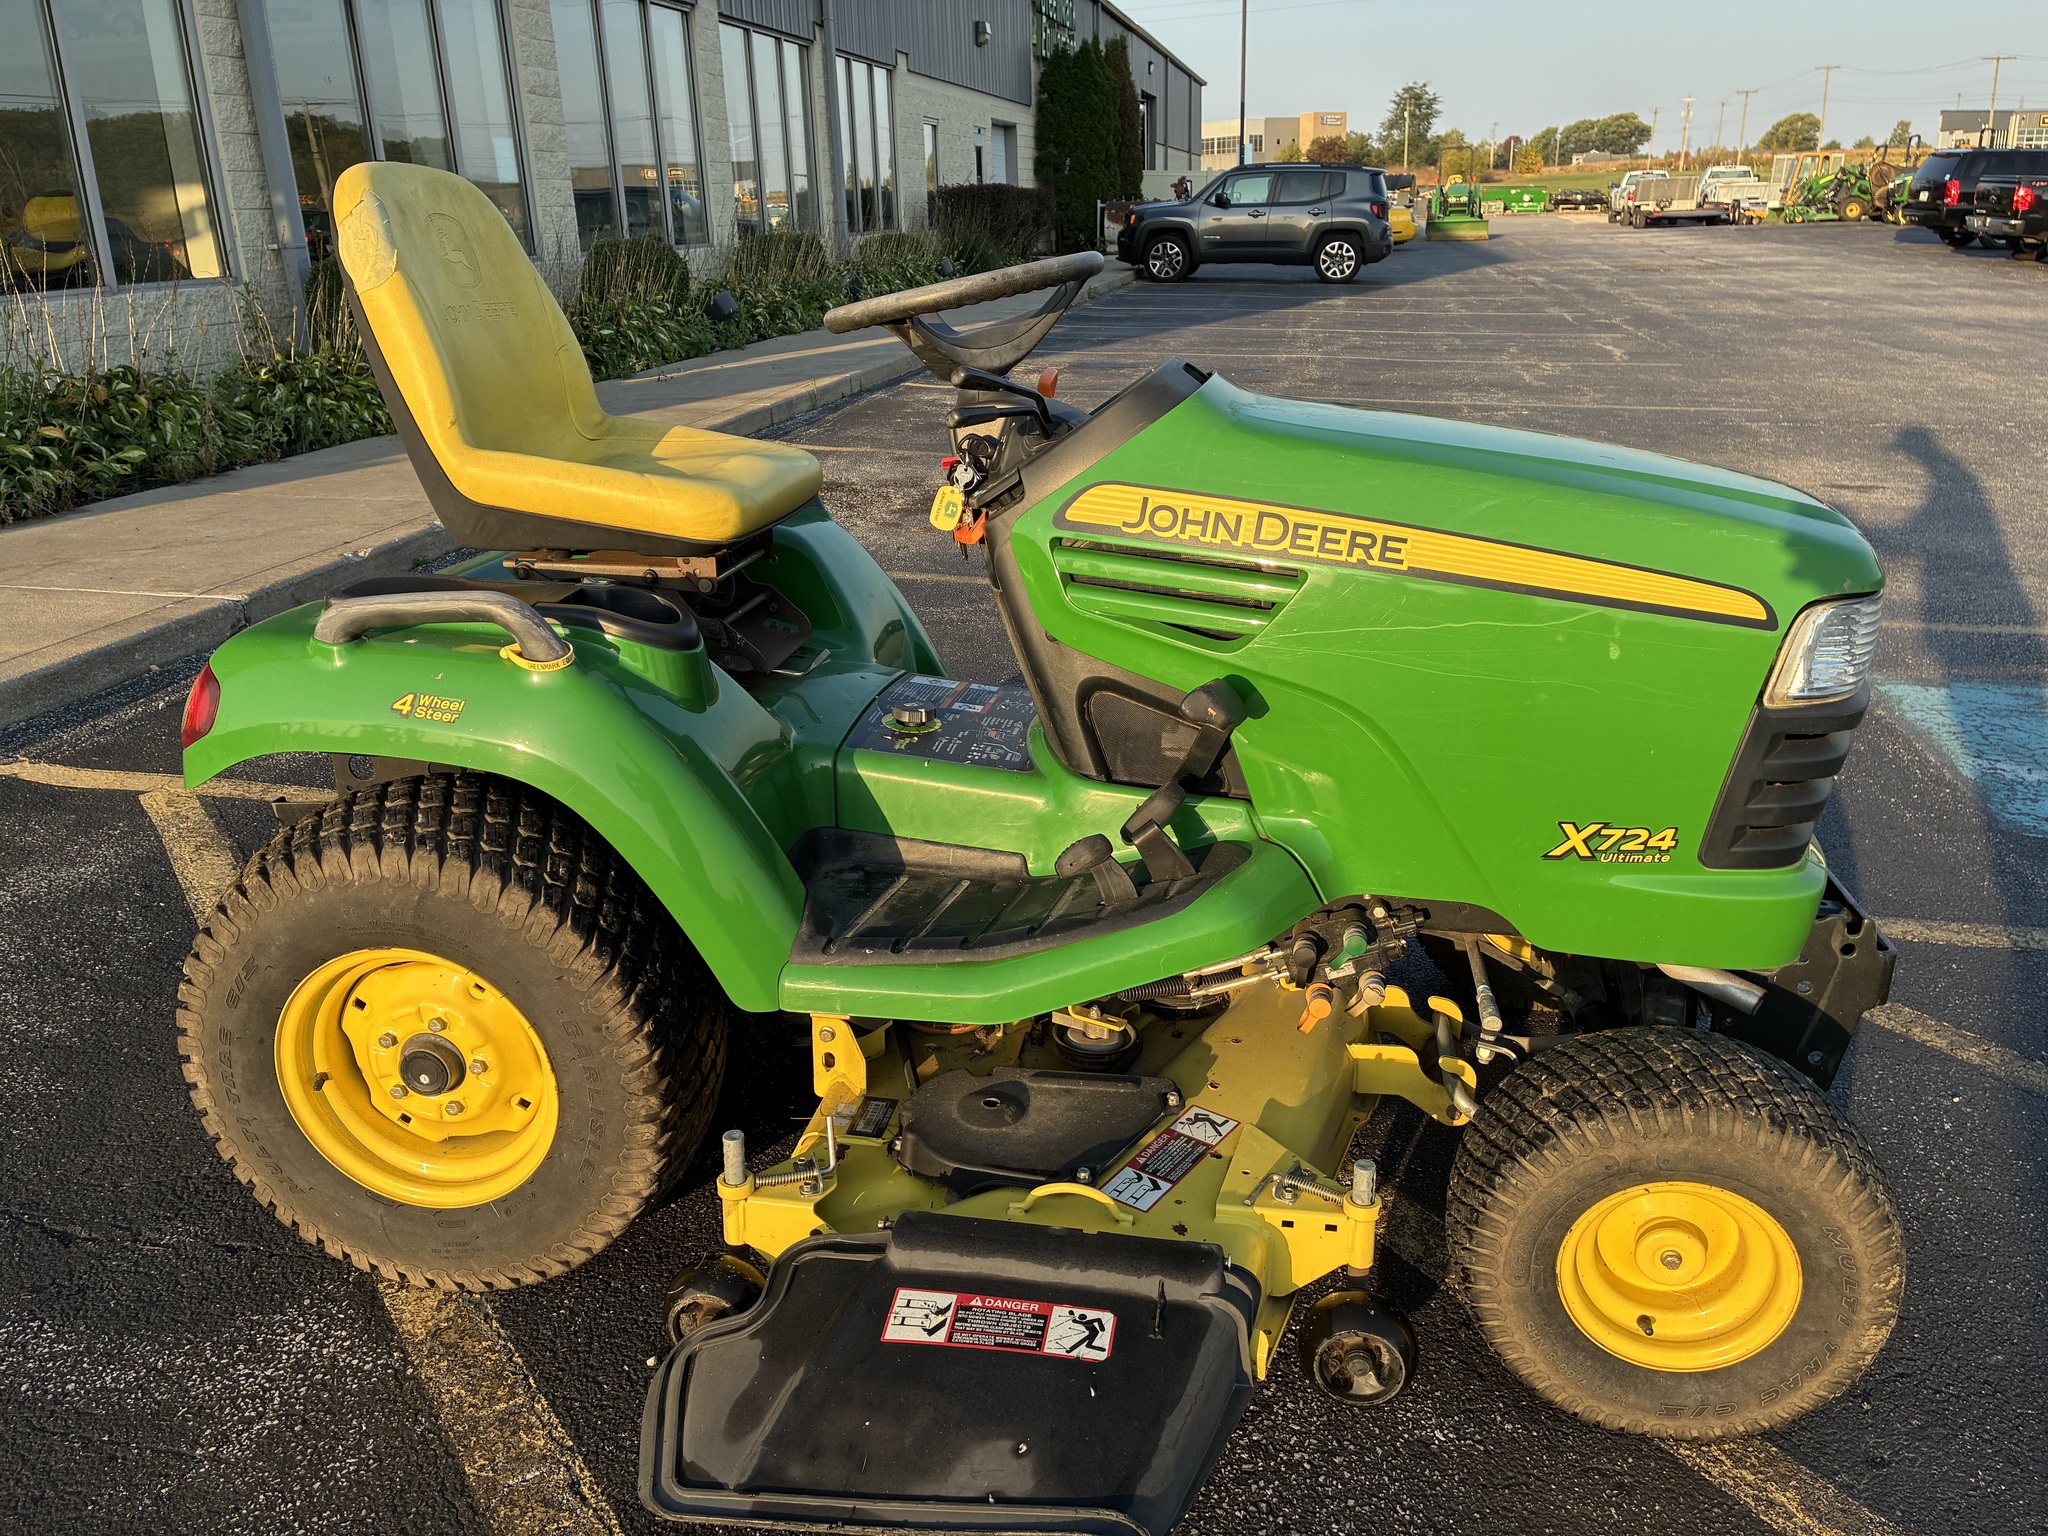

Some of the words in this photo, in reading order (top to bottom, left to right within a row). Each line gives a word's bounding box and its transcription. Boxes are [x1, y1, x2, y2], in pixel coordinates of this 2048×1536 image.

[1122, 496, 1245, 545] JOHN
[1252, 510, 1410, 567] DEERE
[391, 693, 415, 718] 4
[419, 694, 466, 712] Wheel
[414, 706, 460, 723] Steer
[1542, 821, 1679, 860] X724
[1600, 853, 1671, 863] Ultimate
[559, 1018, 607, 1179] CARLISLE
[1141, 1133, 1171, 1158] DANGER
[1822, 1225, 1859, 1328] MULTI
[971, 1307, 1007, 1315] ROTATING
[984, 1298, 1039, 1312] DANGER
[997, 1321, 1031, 1329] OBJECTS
[1523, 1321, 1547, 1349] NHS
[1759, 1341, 1840, 1406] TRAC
